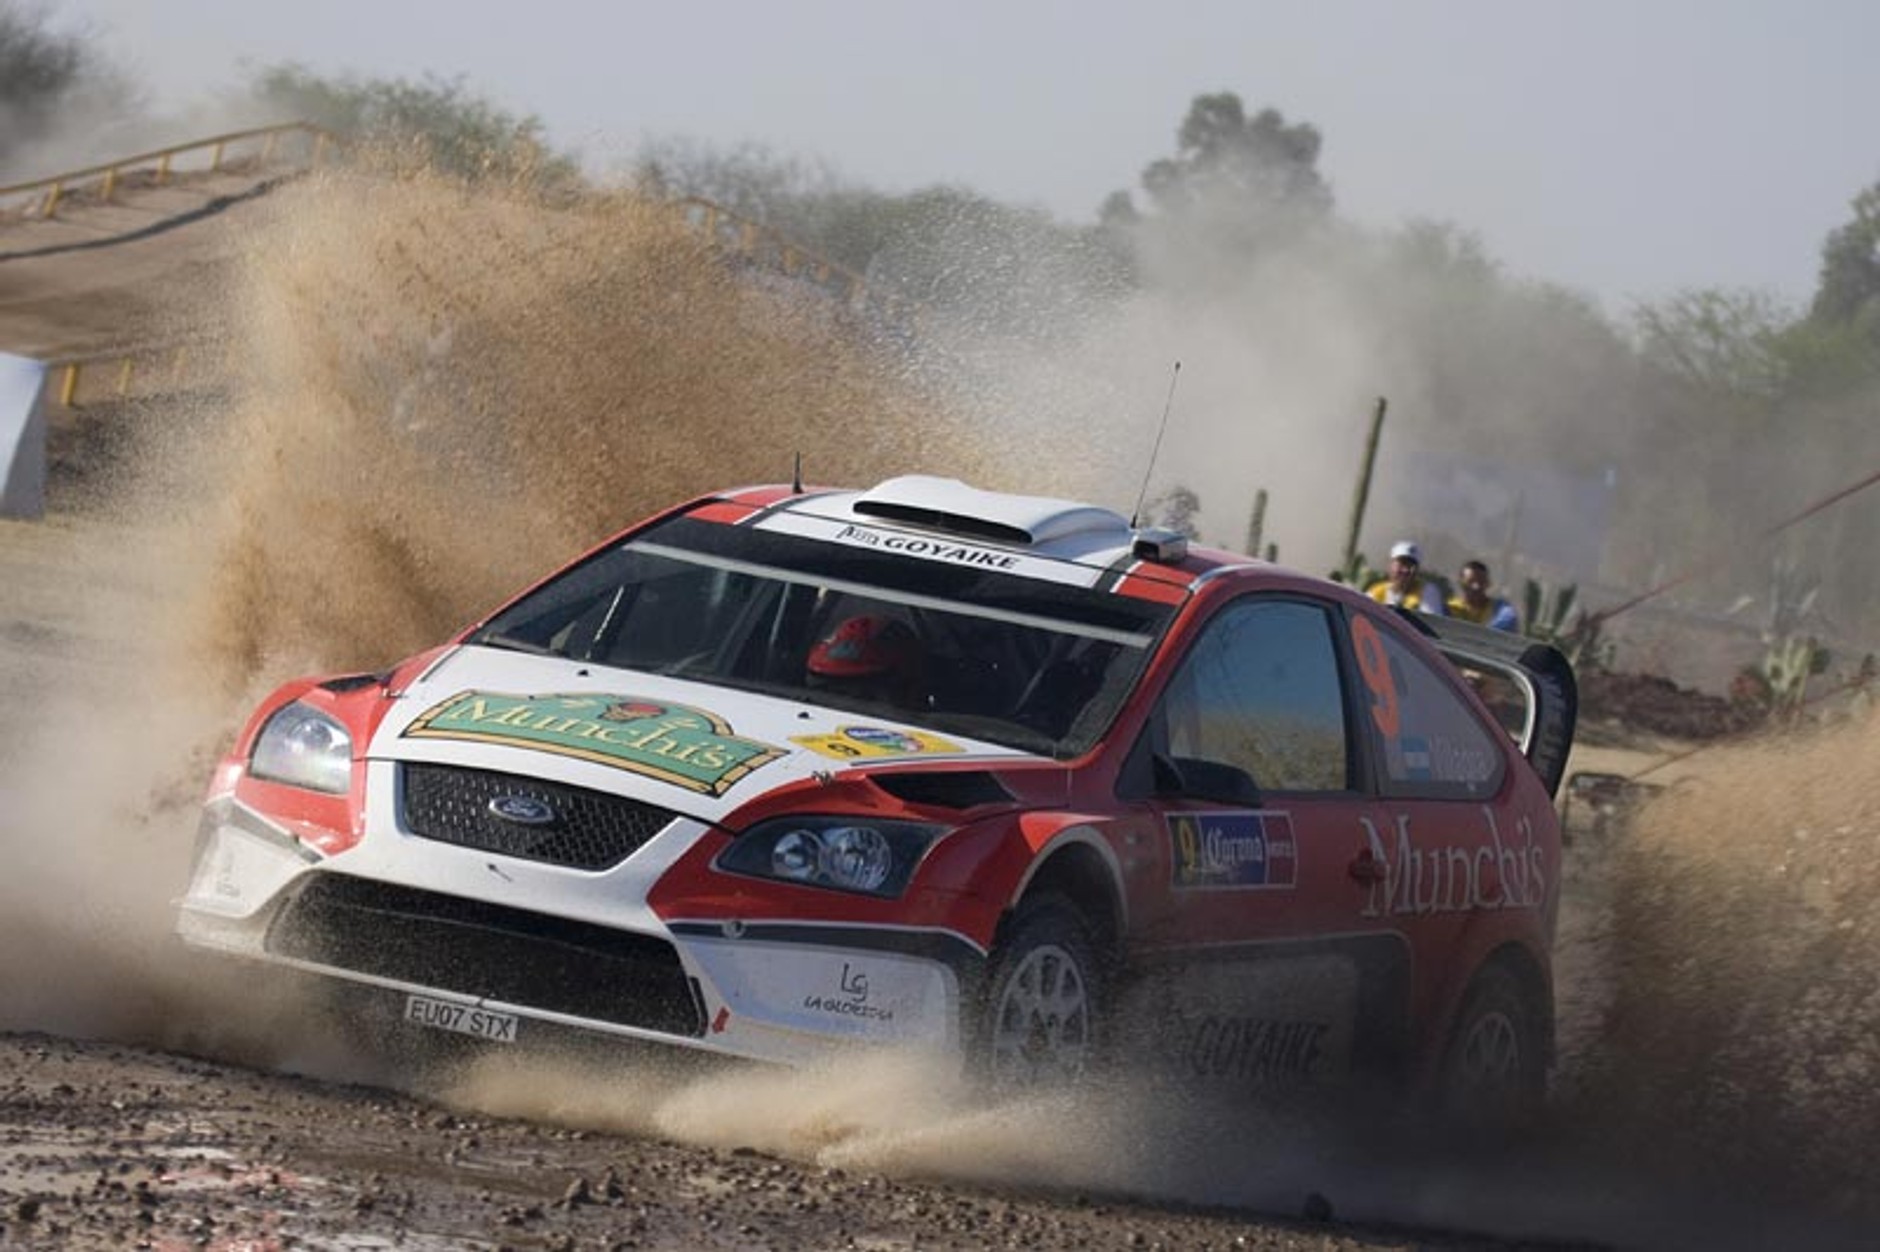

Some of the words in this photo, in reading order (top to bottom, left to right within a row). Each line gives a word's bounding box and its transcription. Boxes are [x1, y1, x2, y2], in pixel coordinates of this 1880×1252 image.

[884, 536, 1021, 570] GOYAIKE
[1352, 612, 1399, 739] 9
[449, 698, 735, 769] Munchi's
[1206, 826, 1264, 869] Corona
[1358, 805, 1545, 917] Munchi's
[410, 1000, 466, 1027] EU07
[470, 1012, 513, 1039] STX
